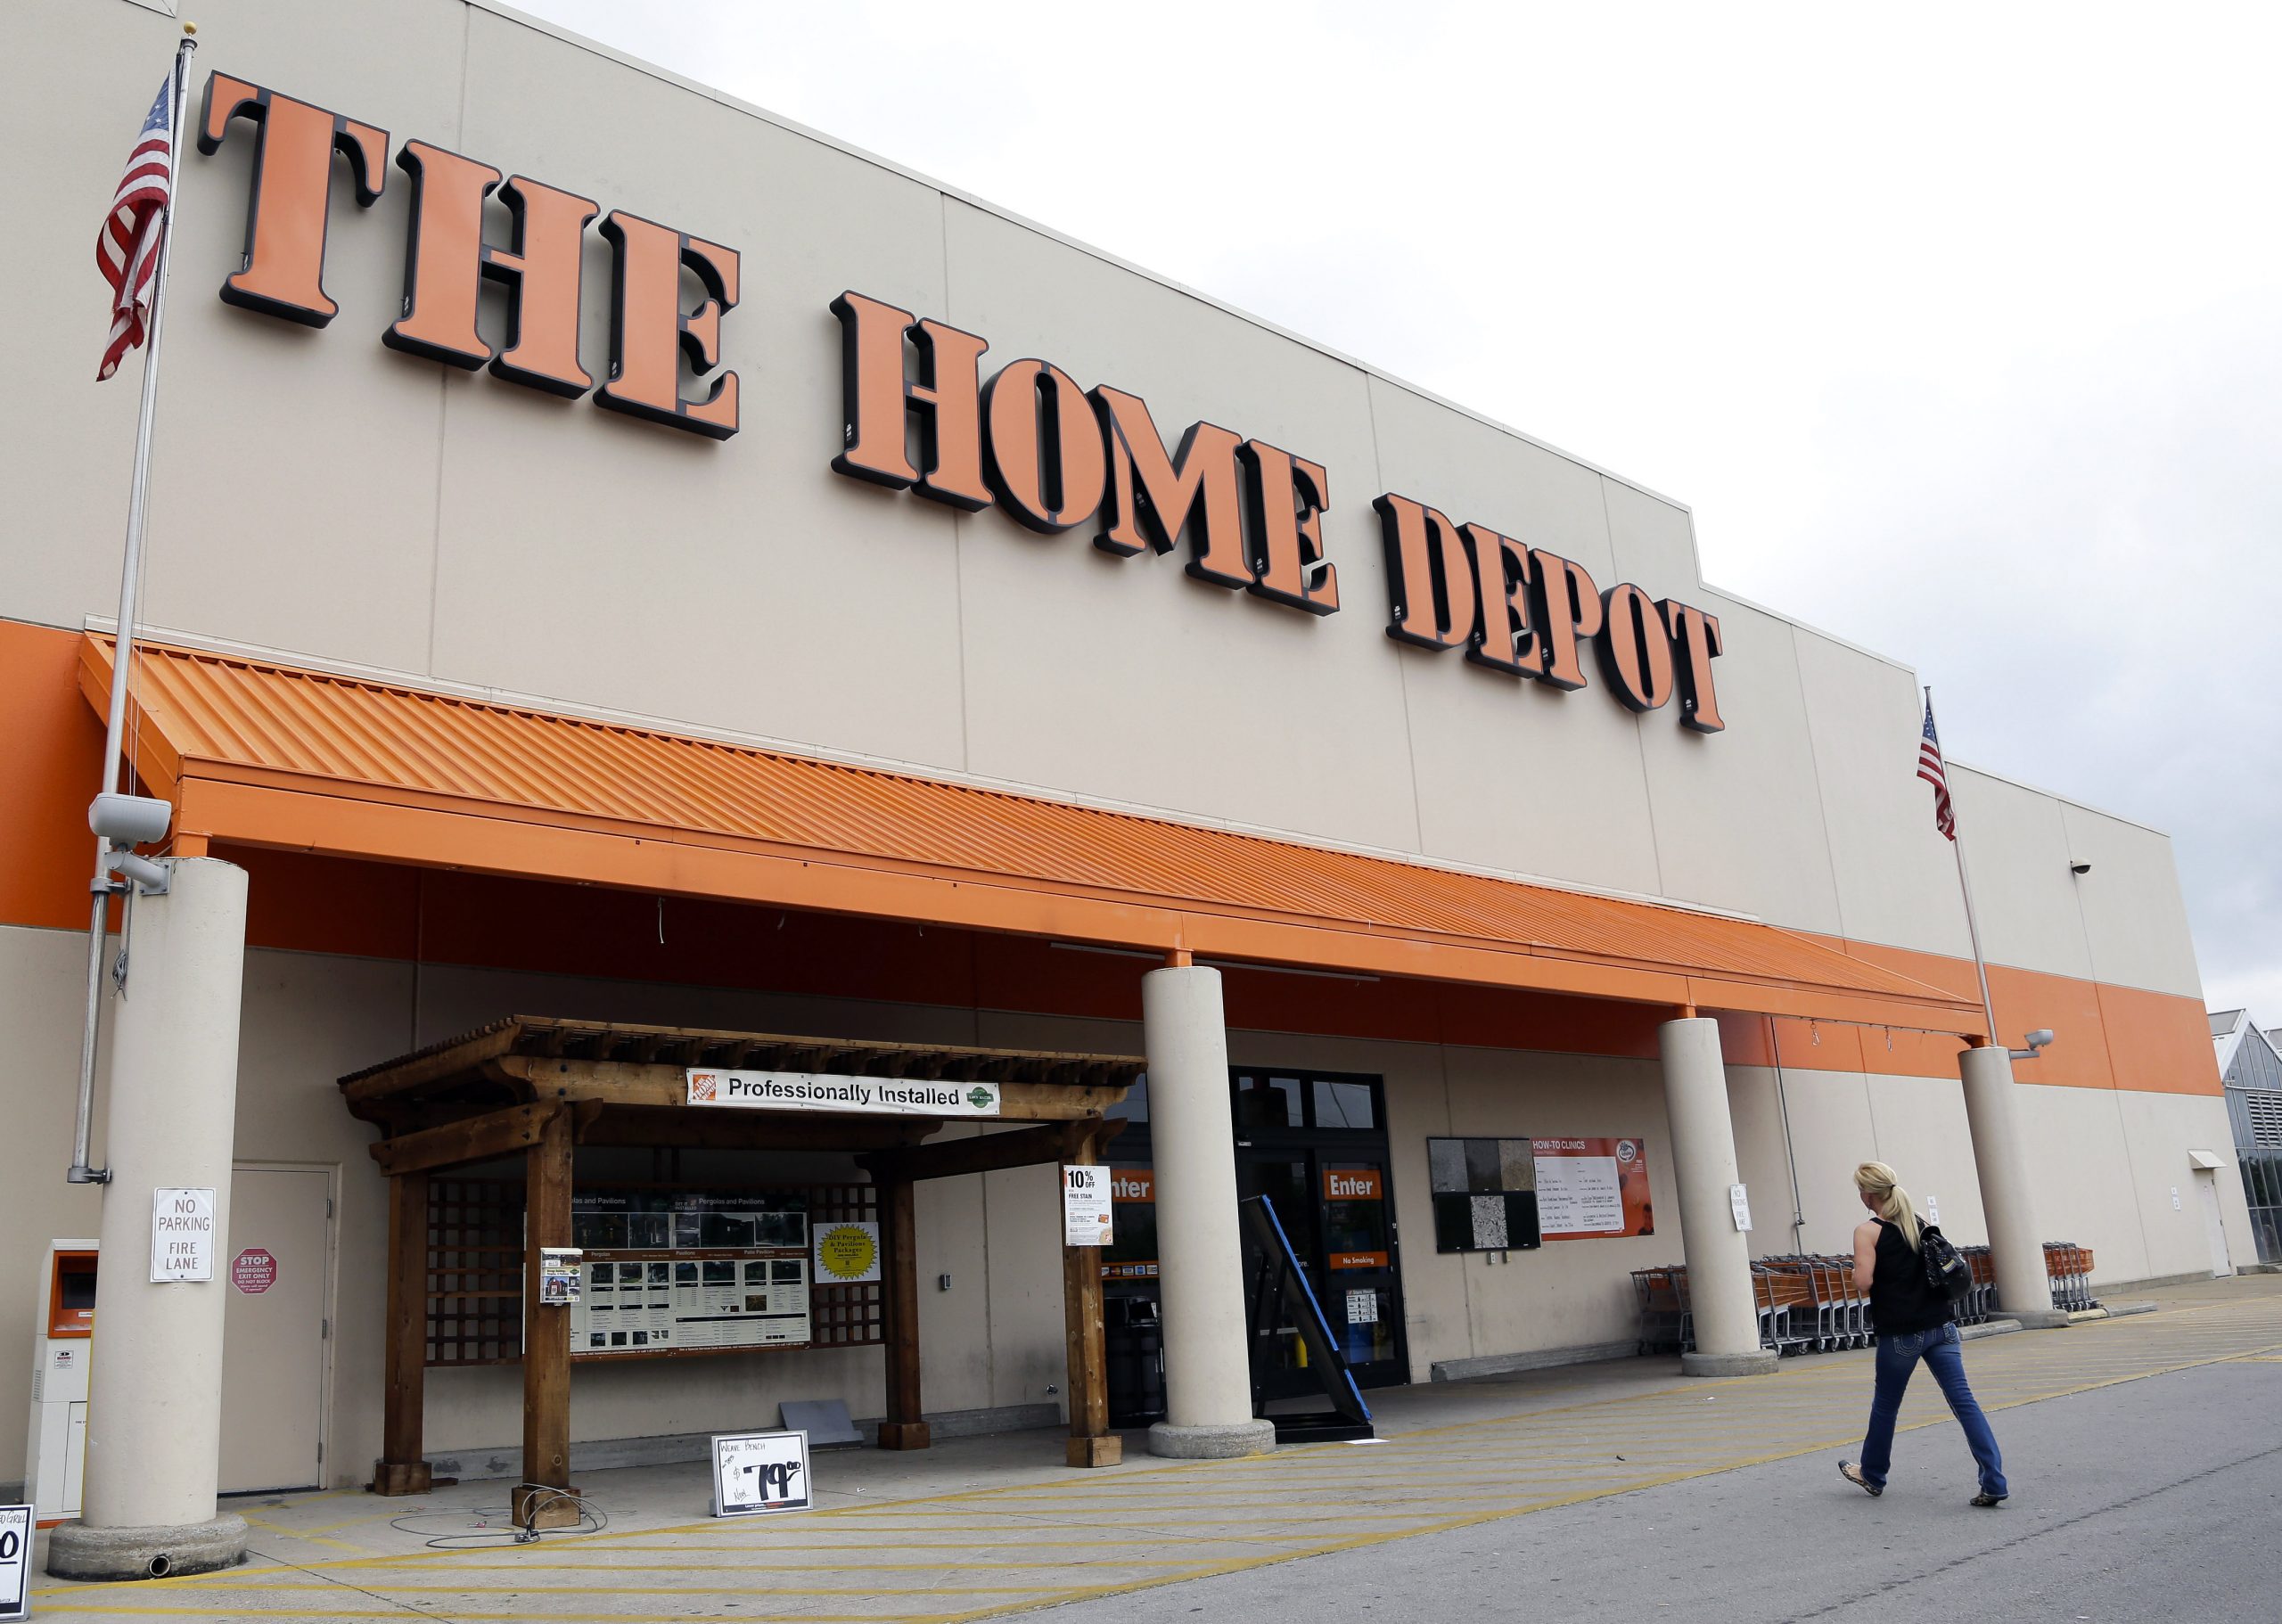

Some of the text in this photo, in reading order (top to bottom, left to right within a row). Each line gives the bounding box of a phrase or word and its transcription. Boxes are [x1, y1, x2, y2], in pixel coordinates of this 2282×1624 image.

[197, 70, 1725, 734] THE HOME DEPOT
[694, 1074, 715, 1100] HOME
[729, 1078, 959, 1105] Professionally Installed
[1533, 1141, 1585, 1150] HOW-TO CLINICS
[1112, 1177, 1149, 1197] nter
[1330, 1175, 1373, 1195] Enter
[175, 1200, 195, 1213] NO
[159, 1217, 210, 1231] PARKING
[169, 1242, 196, 1255] FIRE
[166, 1257, 199, 1270] LANE
[241, 1257, 269, 1265] STOP
[1352, 1256, 1374, 1264] Smoking
[720, 1439, 766, 1452] WEAVE BENCH
[734, 1466, 740, 1481] $
[6, 1510, 27, 1524] GRILL
